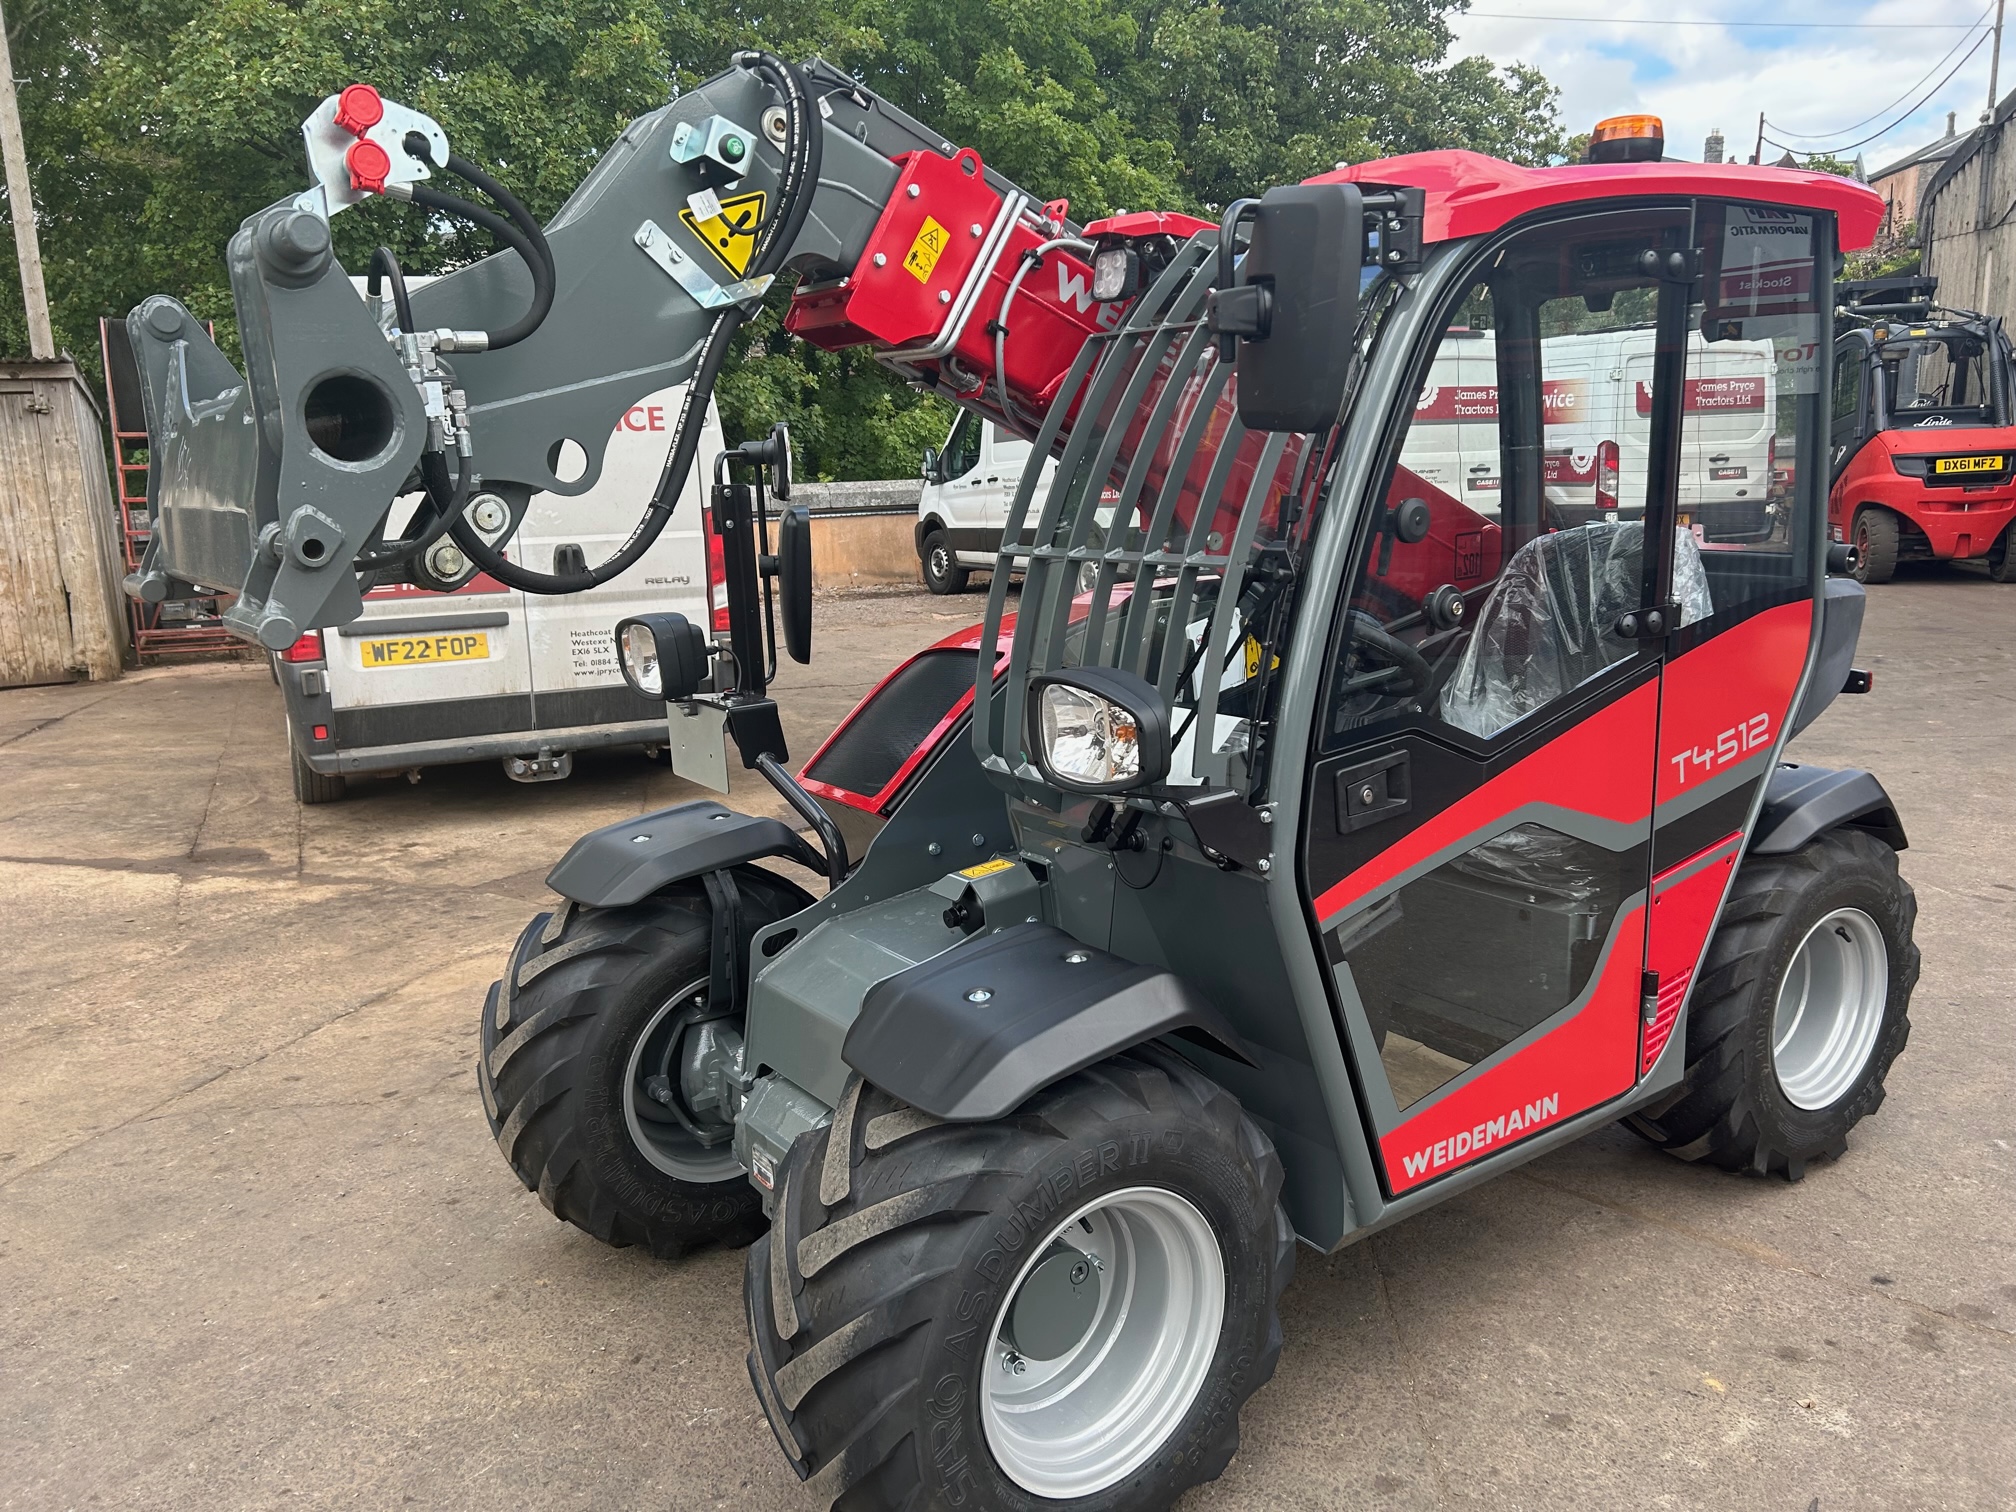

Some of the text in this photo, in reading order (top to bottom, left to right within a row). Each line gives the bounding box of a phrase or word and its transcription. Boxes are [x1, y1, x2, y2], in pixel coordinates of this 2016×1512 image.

[1057, 260, 1124, 330] WE
[1455, 387, 1498, 400] James Pr
[1695, 381, 1755, 397] James Pryce
[1696, 394, 1751, 406] Tractors Ltd
[1455, 404, 1494, 415] Tractors
[1913, 415, 1952, 427] Linde
[1943, 457, 1996, 471] DX61 MFZ
[645, 575, 690, 584] RELAY
[570, 629, 612, 637] Heathcoat
[571, 638, 607, 647] Westexe
[371, 636, 477, 662] WF22 FOP
[571, 647, 610, 656] EX16 5LX
[573, 659, 588, 668] Tel:
[590, 658, 612, 666] 01884
[1671, 712, 1769, 784] T4512
[1402, 1092, 1559, 1179] WEIDEMANN
[943, 1290, 988, 1362] AS
[974, 1139, 1122, 1285] DUMPER
[1128, 1130, 1152, 1167] II
